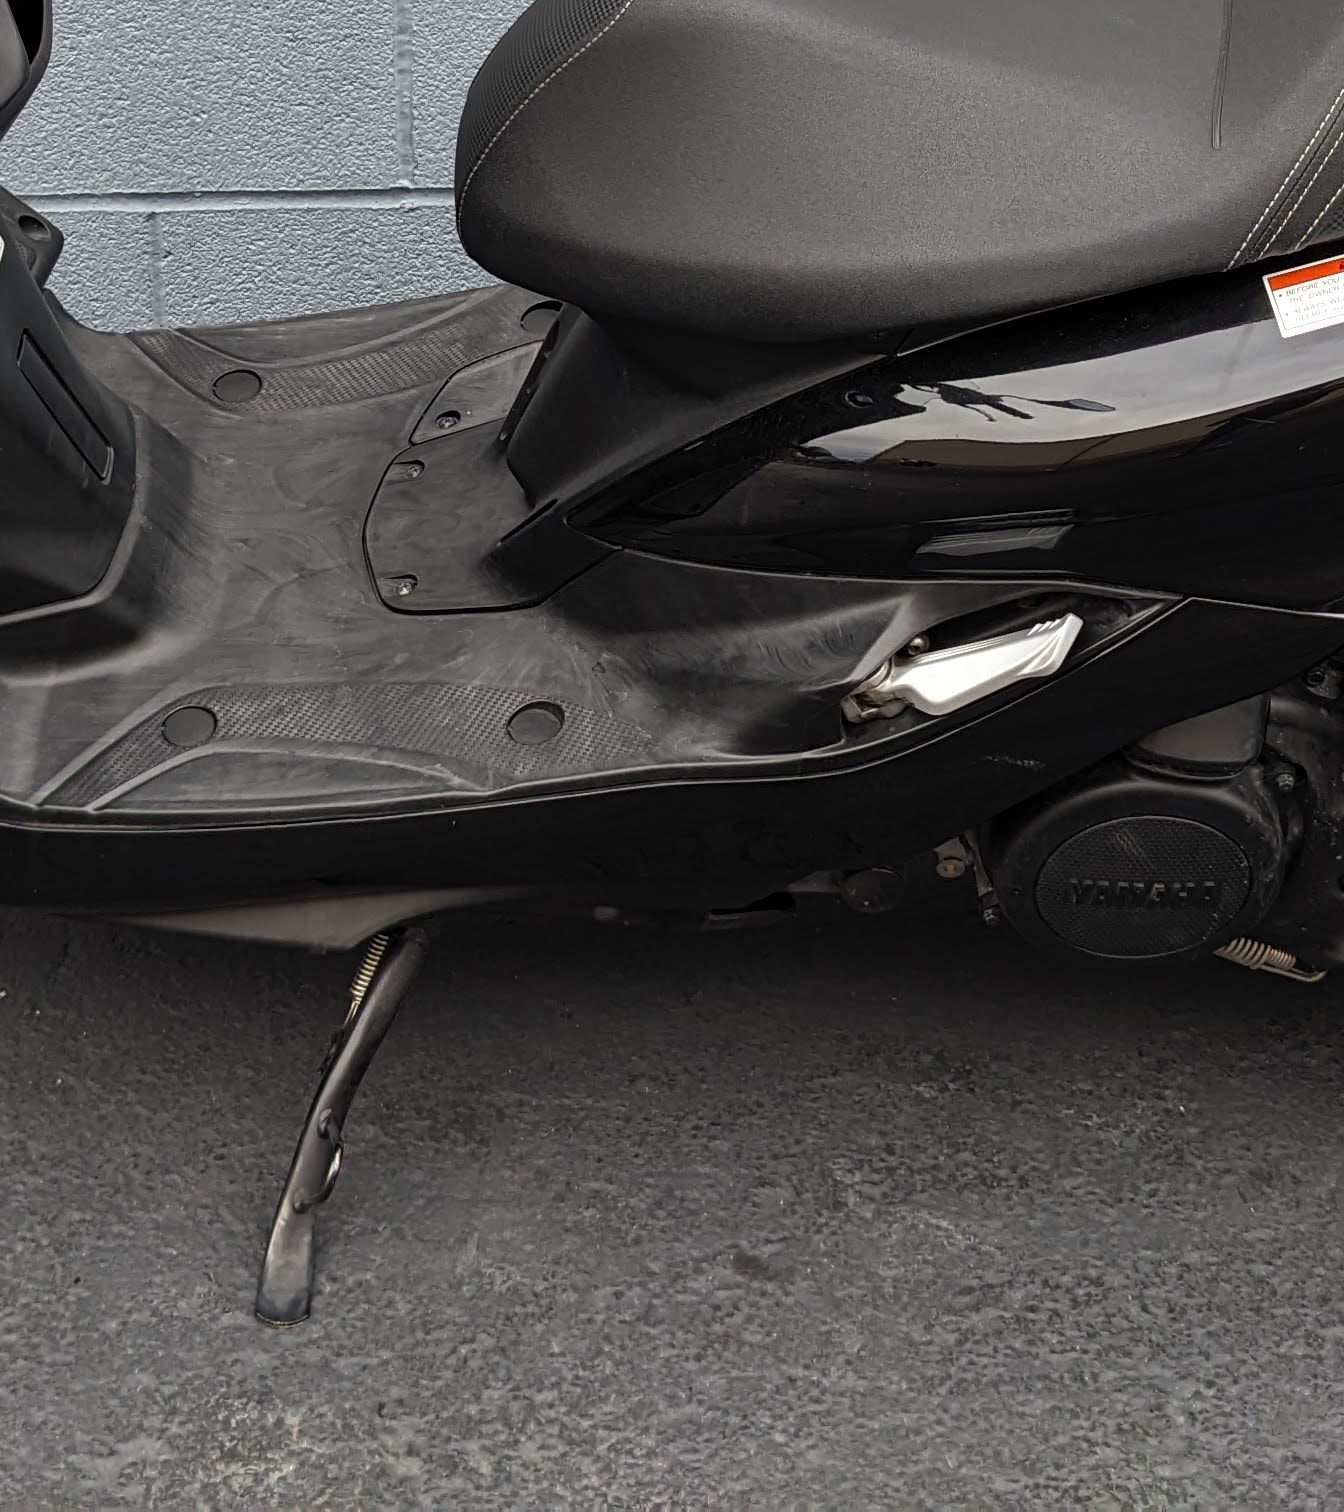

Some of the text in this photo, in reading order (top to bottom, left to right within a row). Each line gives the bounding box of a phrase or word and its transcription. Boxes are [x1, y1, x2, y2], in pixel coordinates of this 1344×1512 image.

[1286, 282, 1319, 296] BEFORE
[1322, 276, 1340, 286] YOU
[1289, 294, 1304, 303] THE
[1294, 302, 1326, 314] ALWAYS
